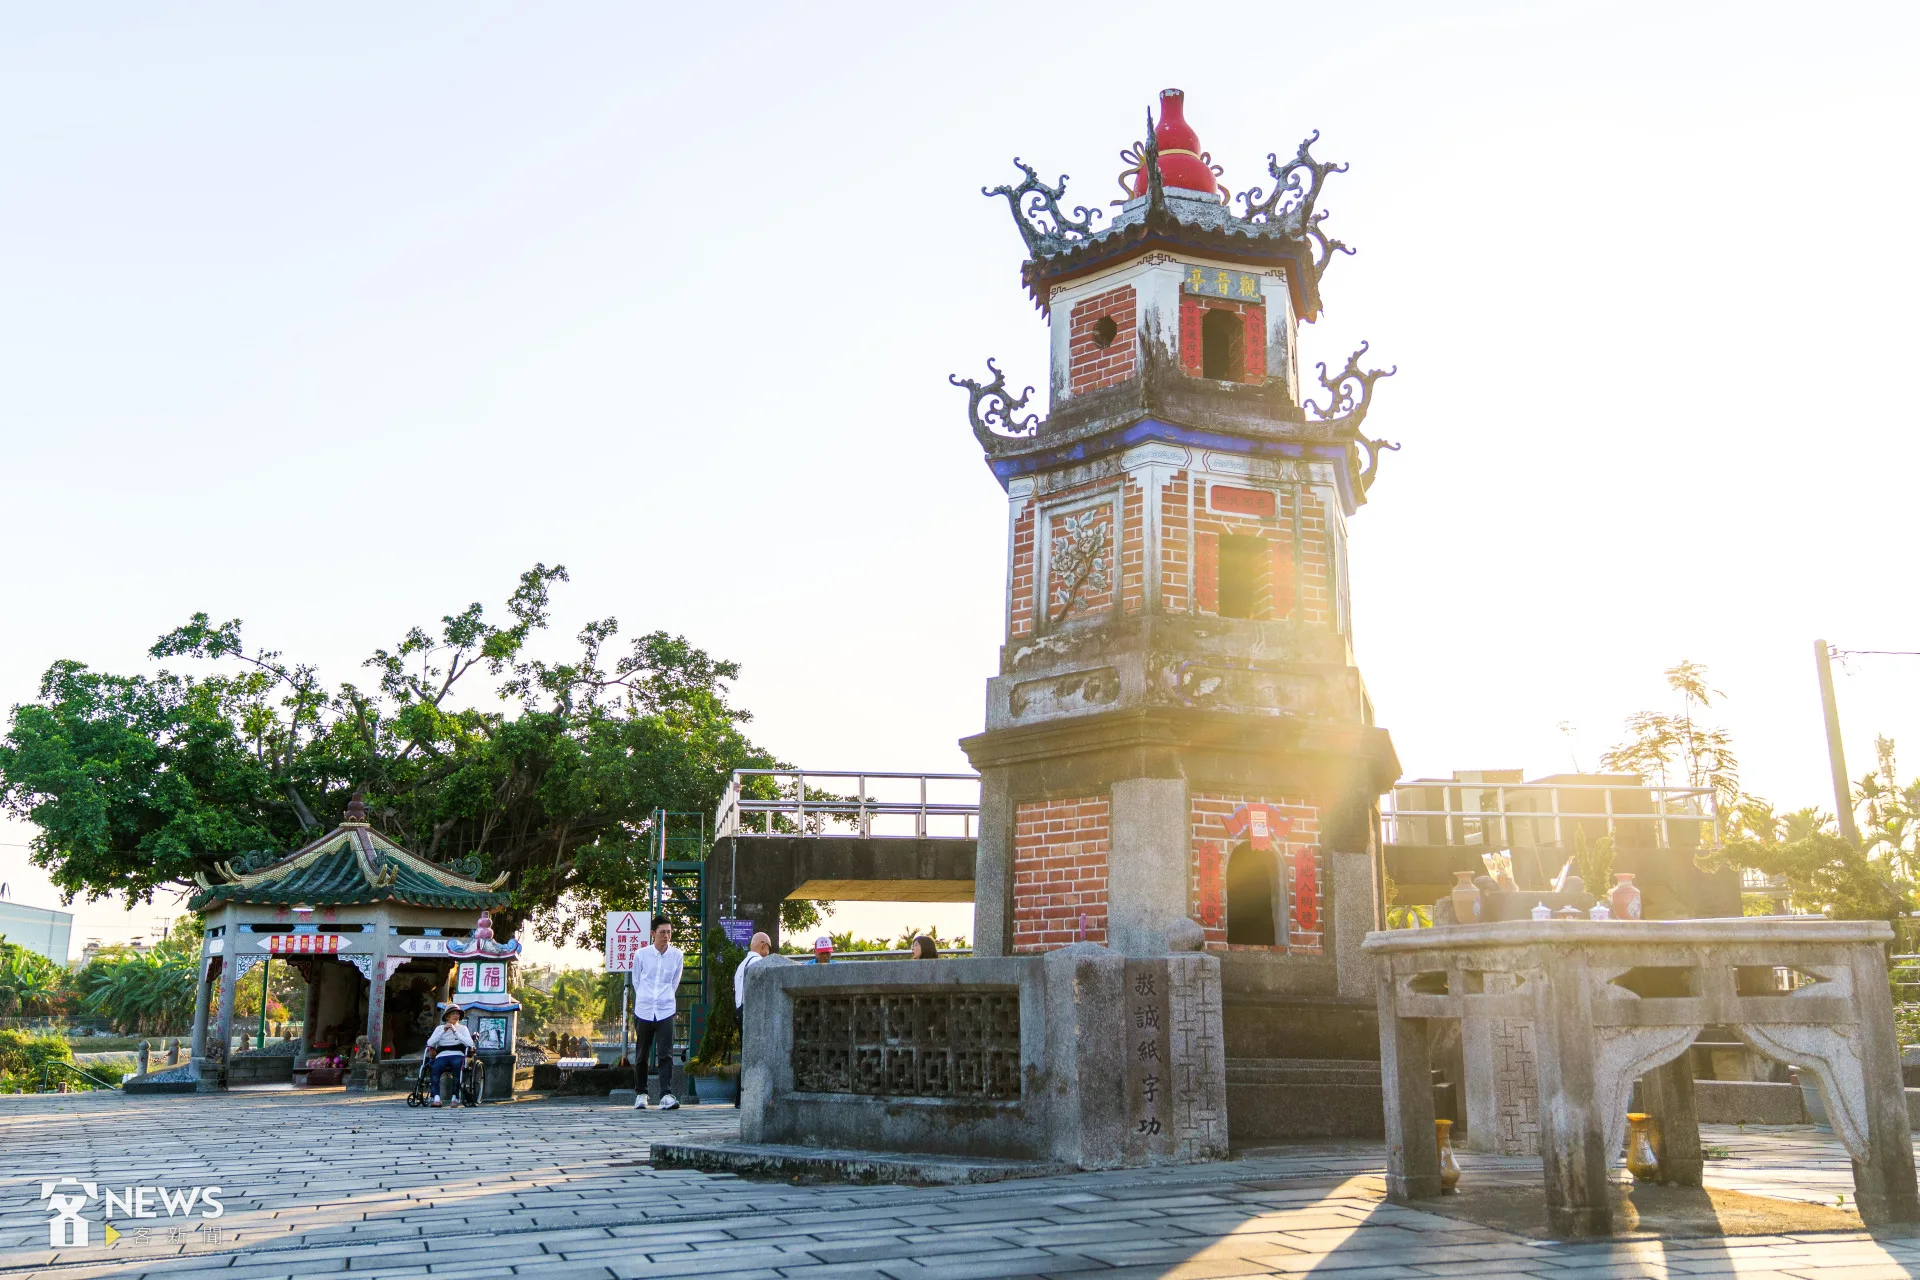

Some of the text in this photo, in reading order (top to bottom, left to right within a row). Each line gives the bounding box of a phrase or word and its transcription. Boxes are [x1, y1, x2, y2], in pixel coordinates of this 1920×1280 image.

[1187, 268, 1259, 299] 觀音亭
[408, 939, 447, 953] 調雨順
[616, 935, 627, 970] 請勿進入
[460, 966, 500, 988] 福 福
[1134, 973, 1162, 1137] 敬誠紙字功
